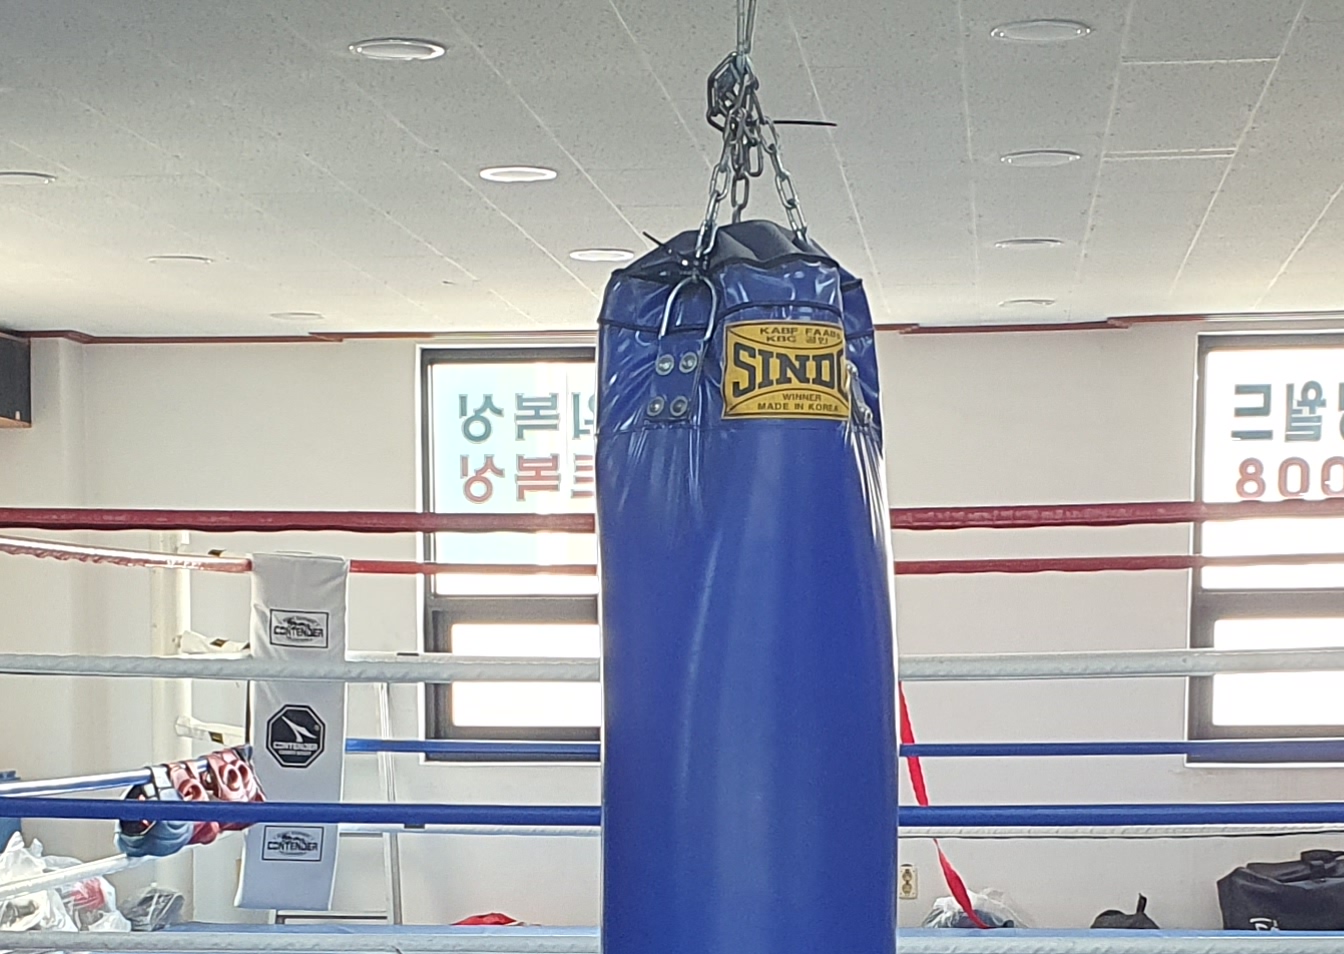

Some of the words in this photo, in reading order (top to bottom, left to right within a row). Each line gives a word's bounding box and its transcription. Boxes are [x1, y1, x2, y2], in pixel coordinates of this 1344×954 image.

[782, 393, 822, 401] WINNER
[757, 402, 789, 410] MADE
[794, 402, 804, 410] IN
[808, 402, 839, 412] KOREA
